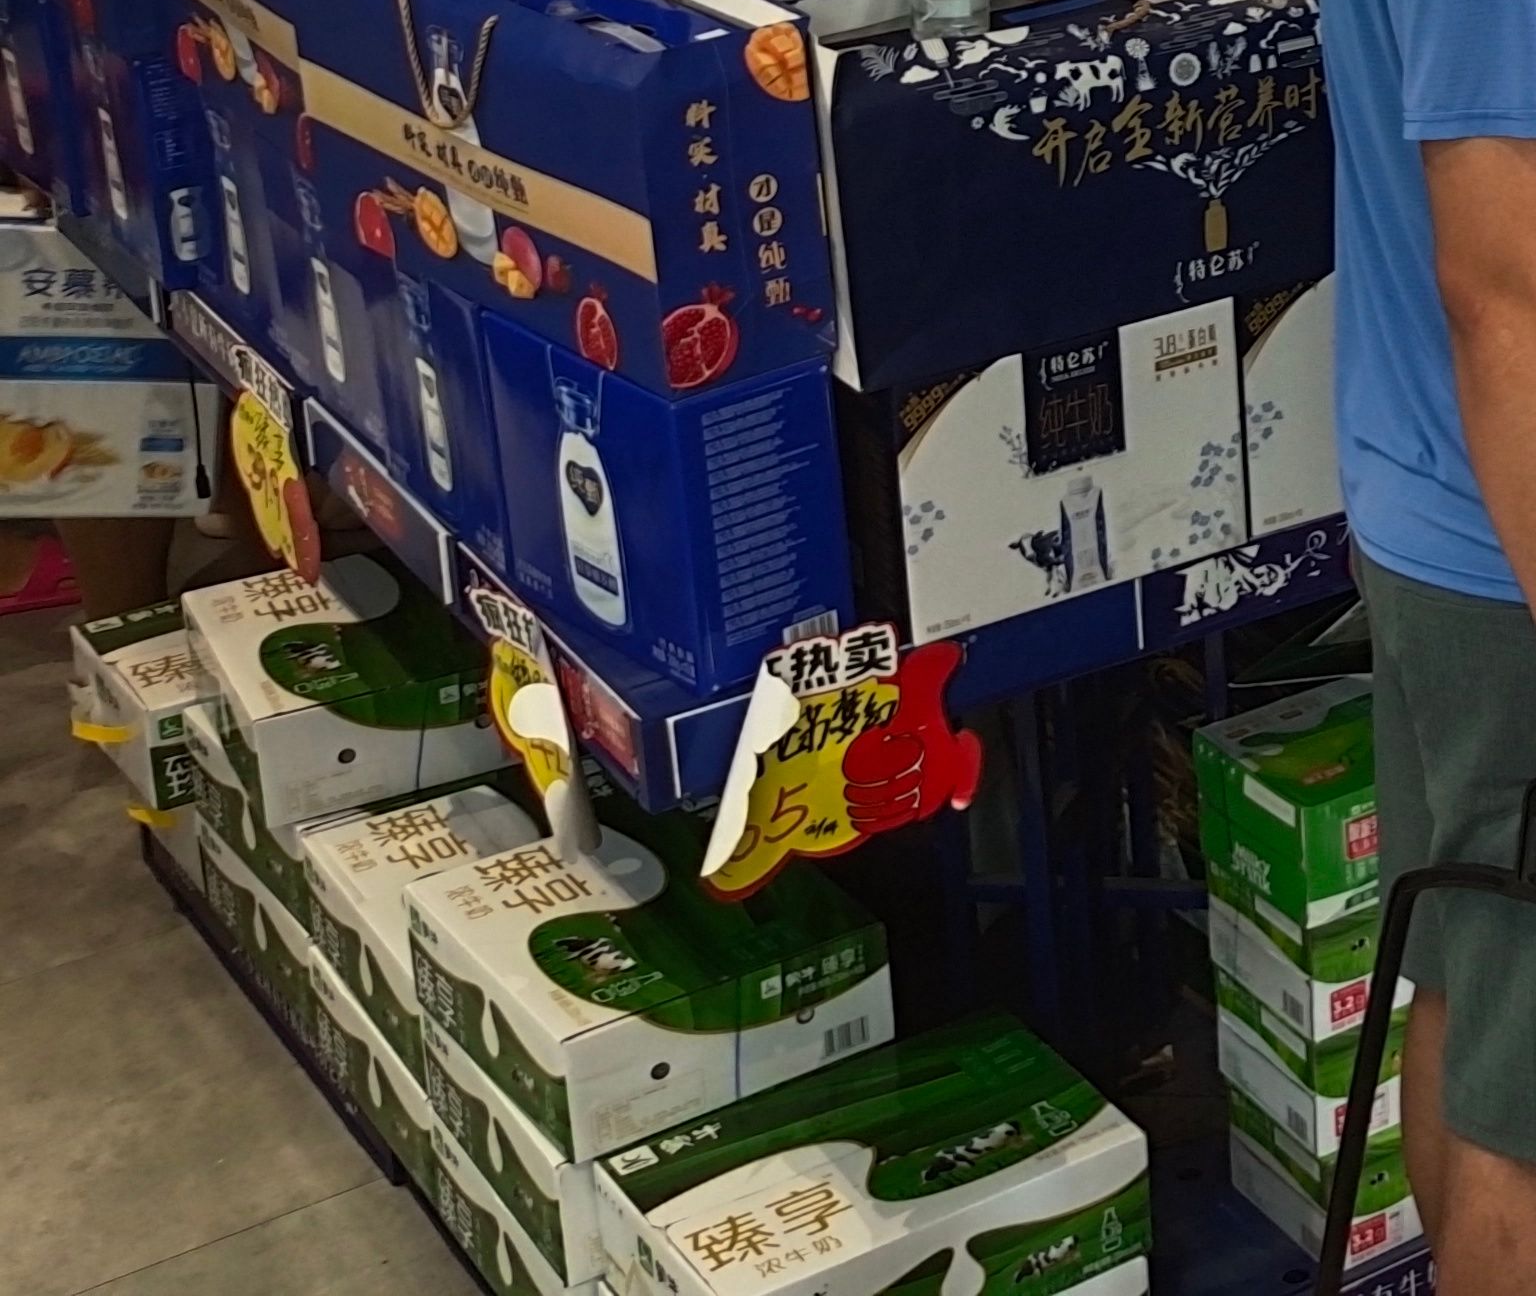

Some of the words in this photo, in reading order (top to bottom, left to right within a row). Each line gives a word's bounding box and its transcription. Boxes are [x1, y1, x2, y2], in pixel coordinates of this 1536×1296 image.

[1188, 252, 1245, 282] 特仑苏
[1049, 346, 1095, 373] 特仑苏
[365, 803, 469, 871] 臻享
[473, 844, 593, 915] 臻享
[684, 1173, 854, 1272] 臻享
[755, 1235, 843, 1278] 浓牛奶
